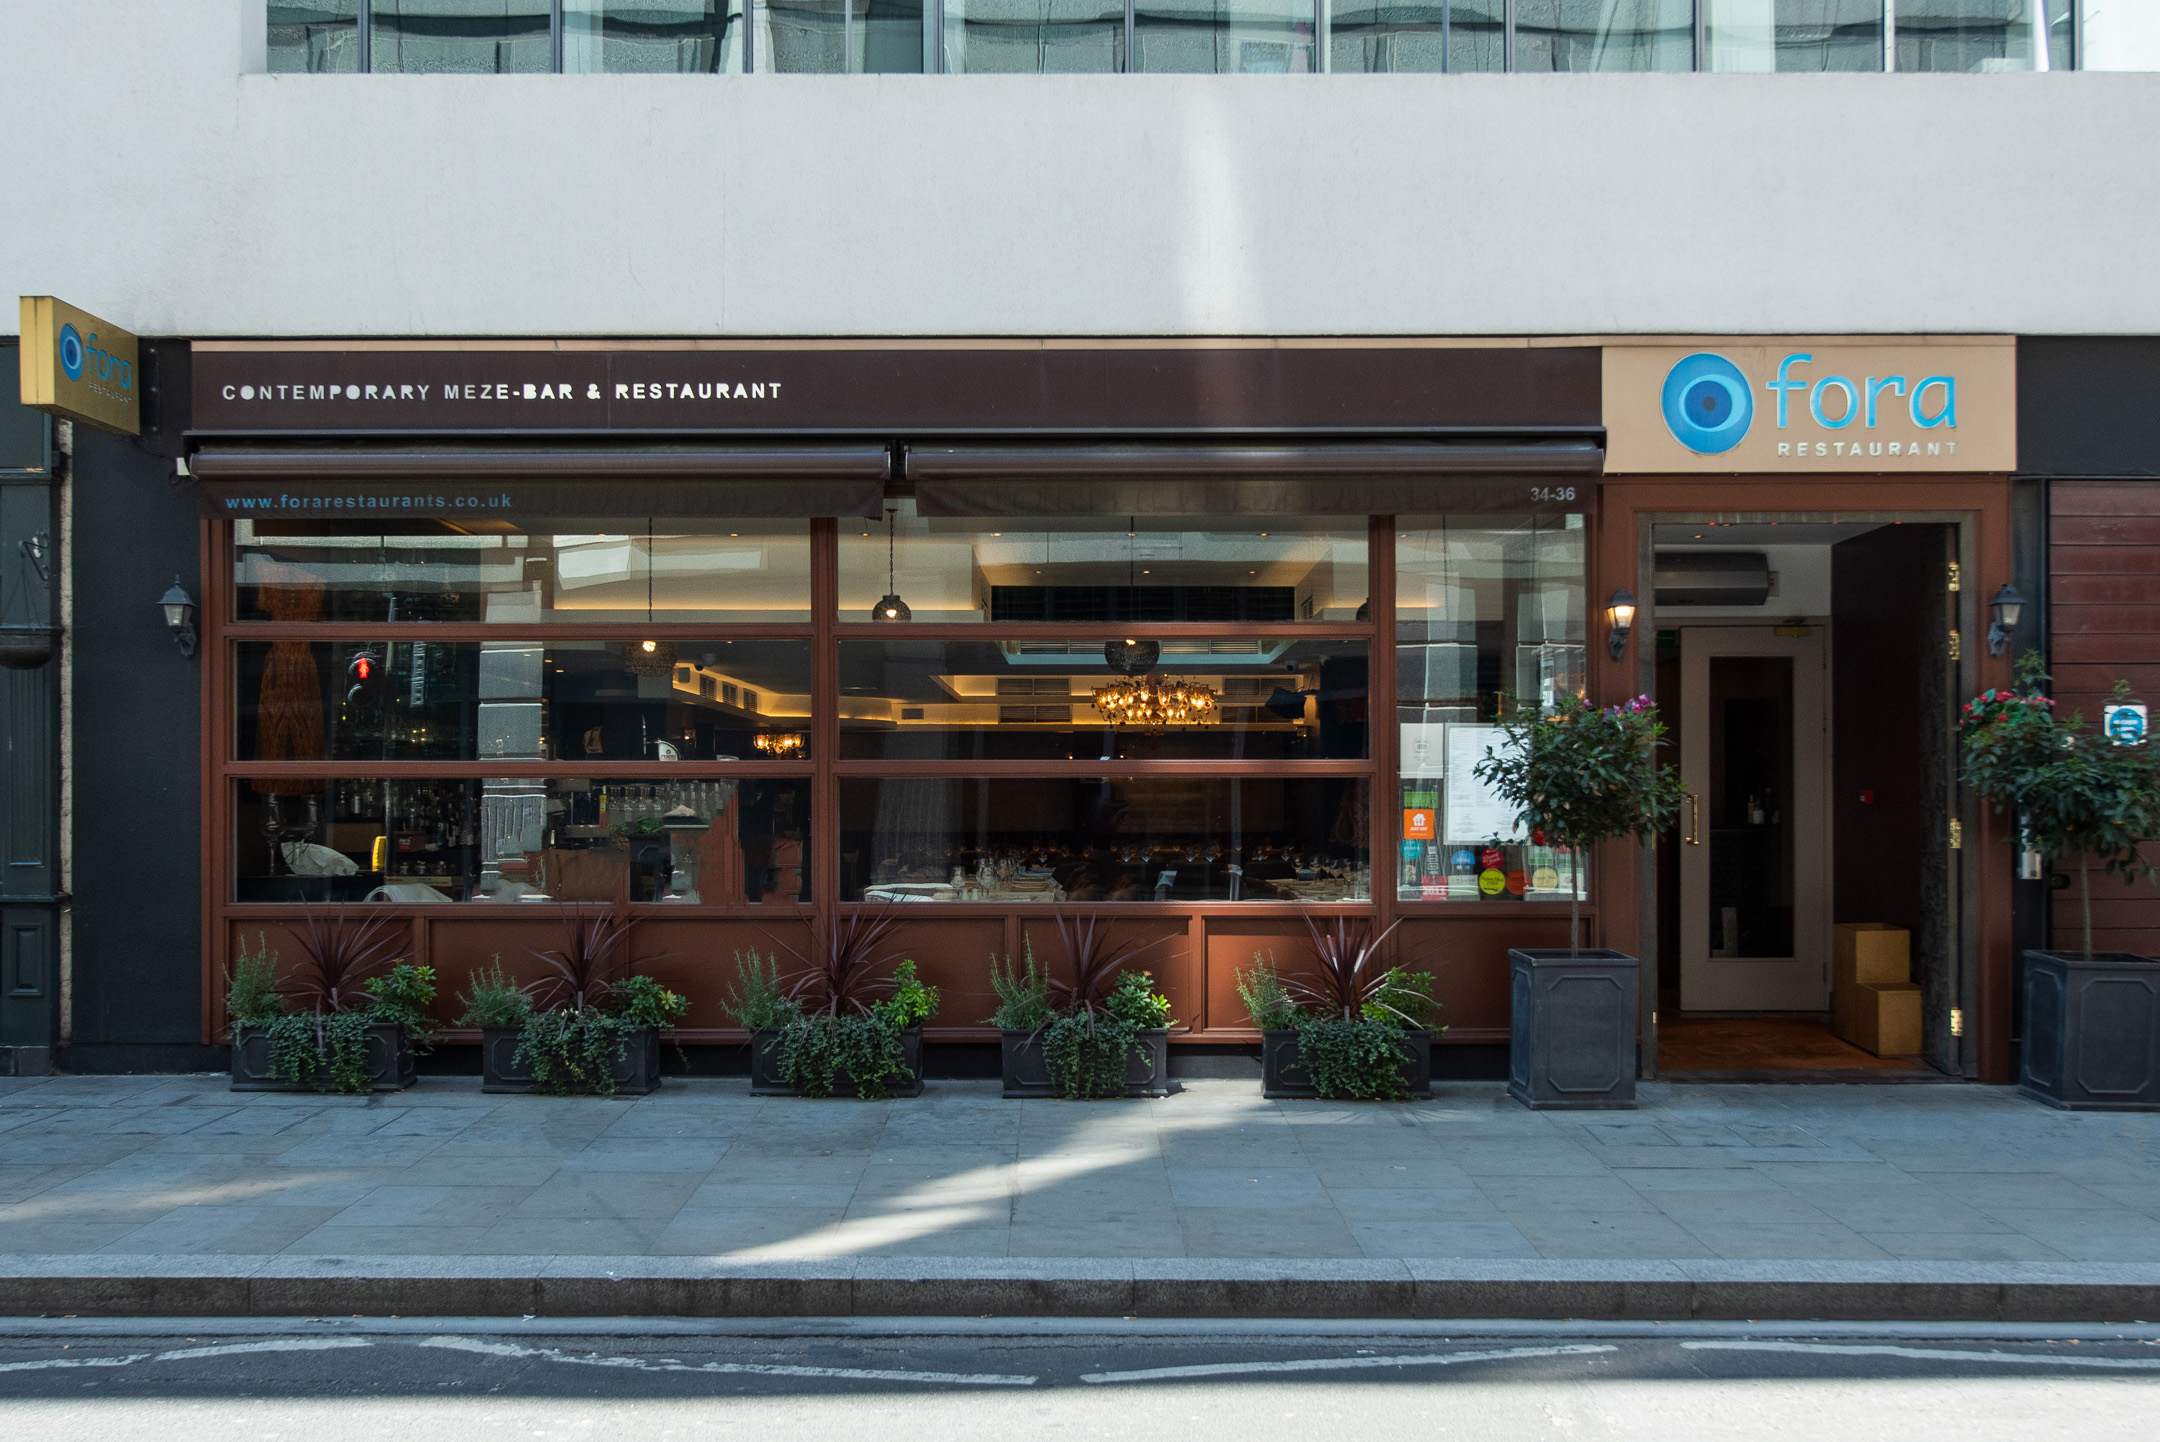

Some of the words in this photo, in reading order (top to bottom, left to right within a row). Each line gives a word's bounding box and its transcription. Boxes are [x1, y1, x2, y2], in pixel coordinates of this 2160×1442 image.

[86, 333, 132, 389] fora
[88, 381, 132, 403] RESTAURANT
[222, 384, 430, 401] CONTEMPORARY
[444, 383, 573, 400] MEZE-BAR
[586, 383, 601, 400] &
[615, 382, 782, 400] RESTAURANT
[1766, 353, 1957, 429] fora
[1778, 442, 1957, 457] RESTAURANT
[225, 493, 513, 509] www.forarestaurants.co.uk
[1530, 487, 1576, 501] 34-36
